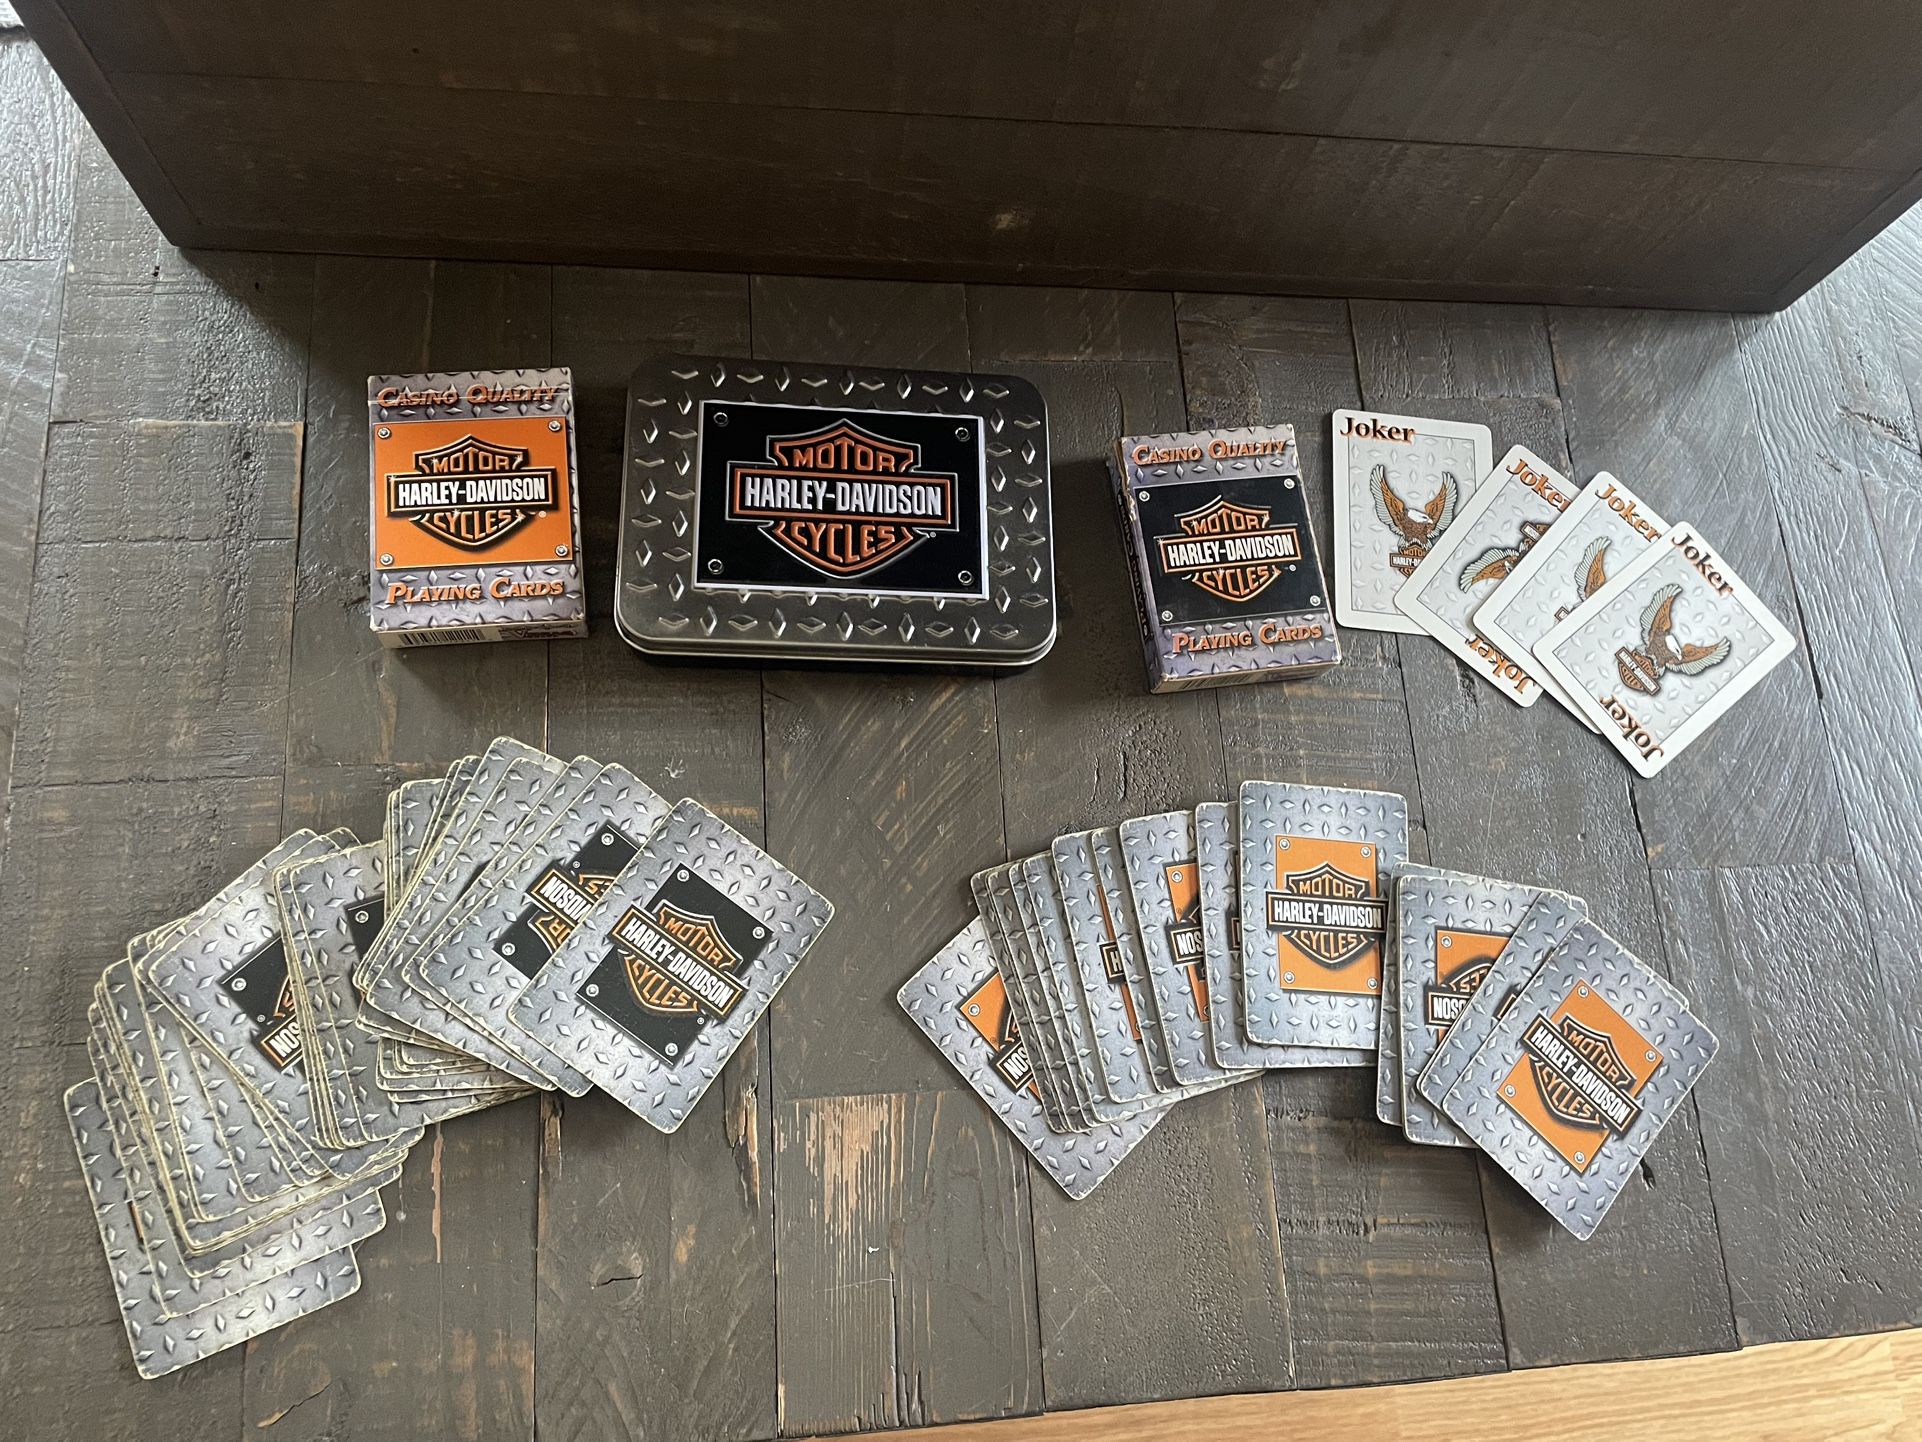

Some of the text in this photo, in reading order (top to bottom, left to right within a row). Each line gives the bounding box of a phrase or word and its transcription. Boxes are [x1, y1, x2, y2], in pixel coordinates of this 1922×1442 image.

[1340, 416, 1416, 443] Joker
[433, 448, 510, 473] MOTOR
[793, 436, 895, 473] MOTOR
[1131, 439, 1288, 466] CASINO QUALITY
[398, 477, 546, 506] HARLEY-DAVIDSON
[744, 477, 942, 516] HARLEY-DAVIDSON
[434, 508, 512, 540] CYCLES
[1193, 508, 1262, 534] MOTOR
[1594, 483, 1662, 543] Joker
[790, 521, 895, 563] CYCLES
[1167, 534, 1295, 567] HARLEY-DAVIDSON
[1203, 565, 1270, 596] CYCLES
[1671, 532, 1734, 596] Joker
[385, 576, 565, 605] PLAYING CARDS
[1172, 623, 1323, 653] PLAYING CARDS
[1465, 633, 1537, 695] Joker
[1599, 694, 1666, 761] Joker
[1299, 874, 1355, 897] MOTOR
[1273, 899, 1382, 928] HARLEY-DAVIDSON
[664, 916, 723, 967] MOTOR
[1300, 930, 1357, 958] CYCLES
[620, 917, 735, 1009] HARLEY-DAVIDSON
[630, 959, 691, 1008] CYCLES
[1568, 1029, 1621, 1082] MOTOR
[1530, 1025, 1631, 1127] HARLEY-DAVIDSON
[1541, 1063, 1593, 1118] CYCLES
